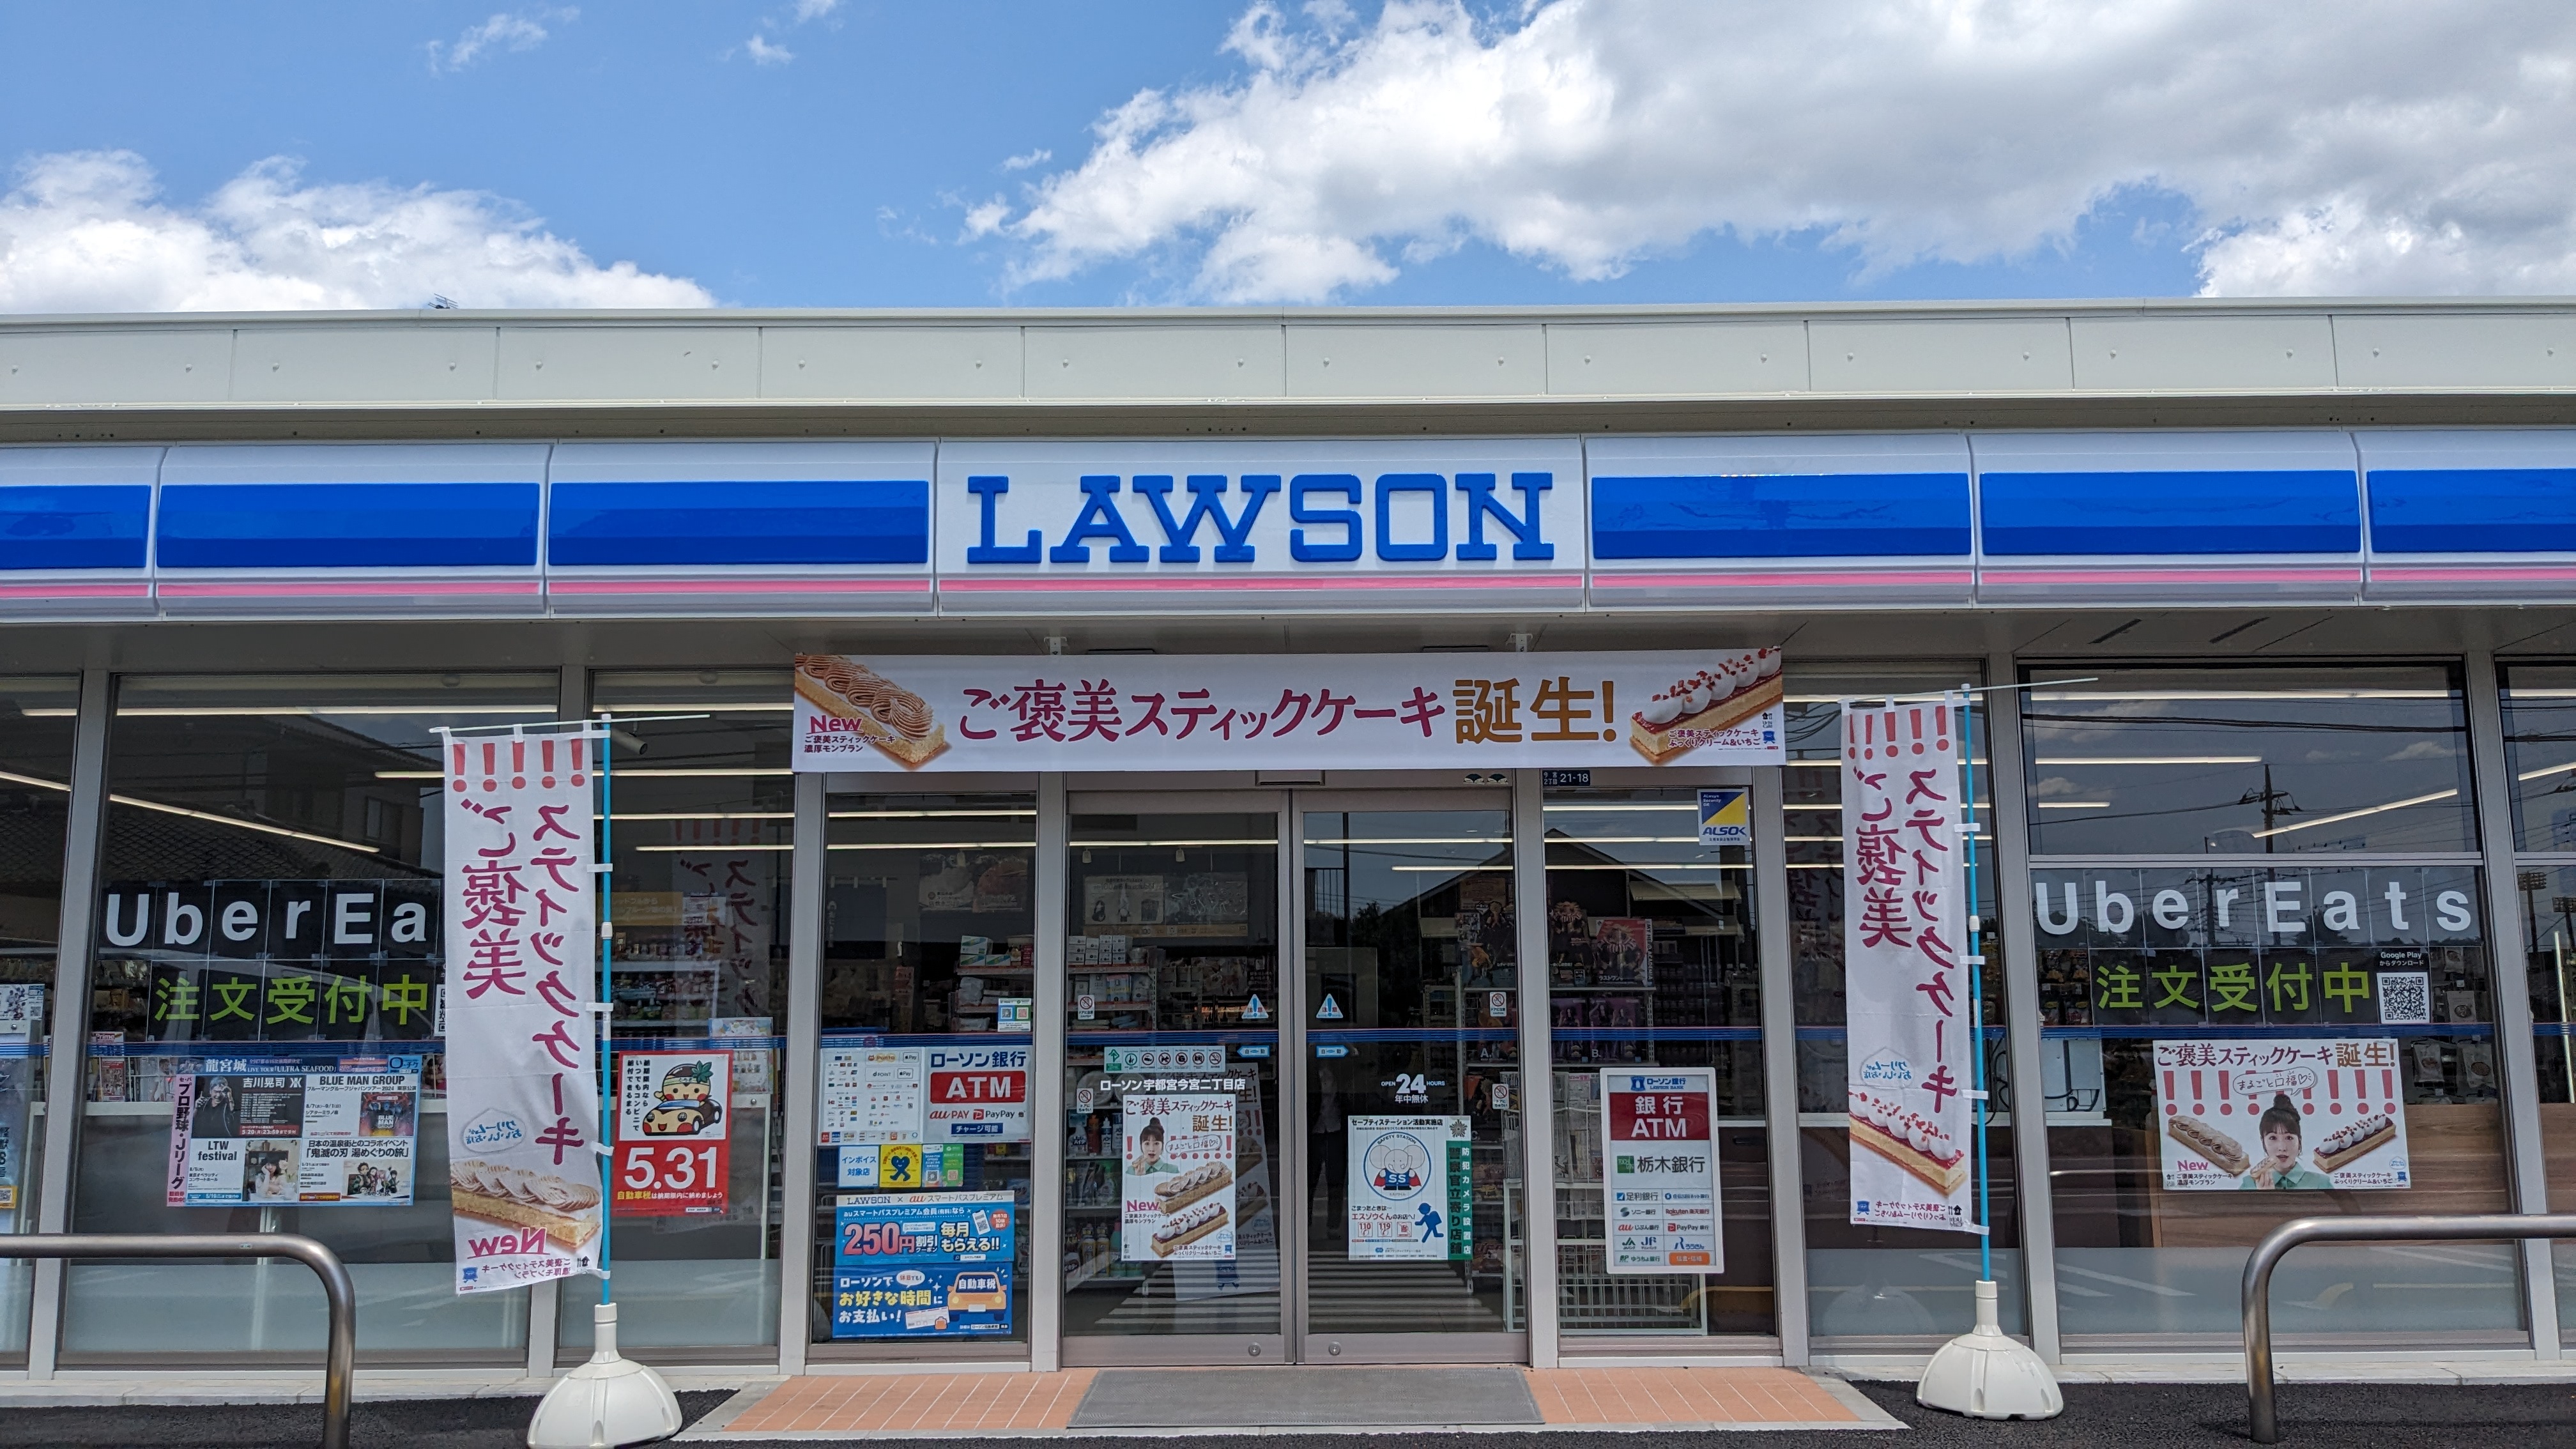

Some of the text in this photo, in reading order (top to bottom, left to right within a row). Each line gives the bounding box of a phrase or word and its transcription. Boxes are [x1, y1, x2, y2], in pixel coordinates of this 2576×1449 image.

[967, 472, 1554, 564] LAWSON
[810, 715, 862, 732] New
[1669, 729, 1759, 738] ご褒美スティックケーキ
[804, 744, 863, 753] 濃厚モンブラン
[1560, 774, 1588, 782] 21-18
[1702, 827, 1747, 837] ALSOK
[2096, 962, 2371, 1013] 注文受付中
[155, 974, 427, 1025] 注文受付中
[206, 1059, 247, 1072] 龍宮城
[931, 1051, 1026, 1068] ローソン銀行
[243, 1077, 285, 1087] 吉川晃司
[319, 1076, 404, 1085] BLUE MAN GROUP
[1100, 1078, 1246, 1091] ローソン宇都宮今宮二丁目店
[1396, 1073, 1426, 1094] 24
[946, 1077, 1011, 1098] ATM
[1395, 1094, 1429, 1103] 年中無休
[1635, 1096, 1683, 1114] 銀行
[1126, 1098, 1233, 1115] ご褒美スティックケーキ
[986, 1110, 1015, 1119] PayPay
[1193, 1115, 1232, 1131] 誕生!
[1631, 1118, 1687, 1137] ATM
[171, 1084, 190, 1189] プロ野球・Jリーグ
[1377, 1135, 1416, 1144] SAFETY STATION
[208, 1141, 229, 1150] LTW
[198, 1151, 237, 1160] festival
[625, 1147, 717, 1189] 5.31
[1637, 1156, 1705, 1173] 栃木銀行
[2177, 1160, 2208, 1170] New
[847, 1196, 891, 1204] LAWSON
[928, 1193, 1004, 1202] スマートパスプレミアム
[1627, 1192, 1658, 1201] 足利銀行
[1126, 1200, 1160, 1211] New
[940, 1222, 969, 1238] 毎月
[916, 1235, 937, 1246] 割引
[840, 1276, 893, 1287] ローソンで
[958, 1278, 996, 1289] 自動車税
[839, 1291, 943, 1307] お好きな時間に
[839, 1310, 901, 1324] お支払い!
